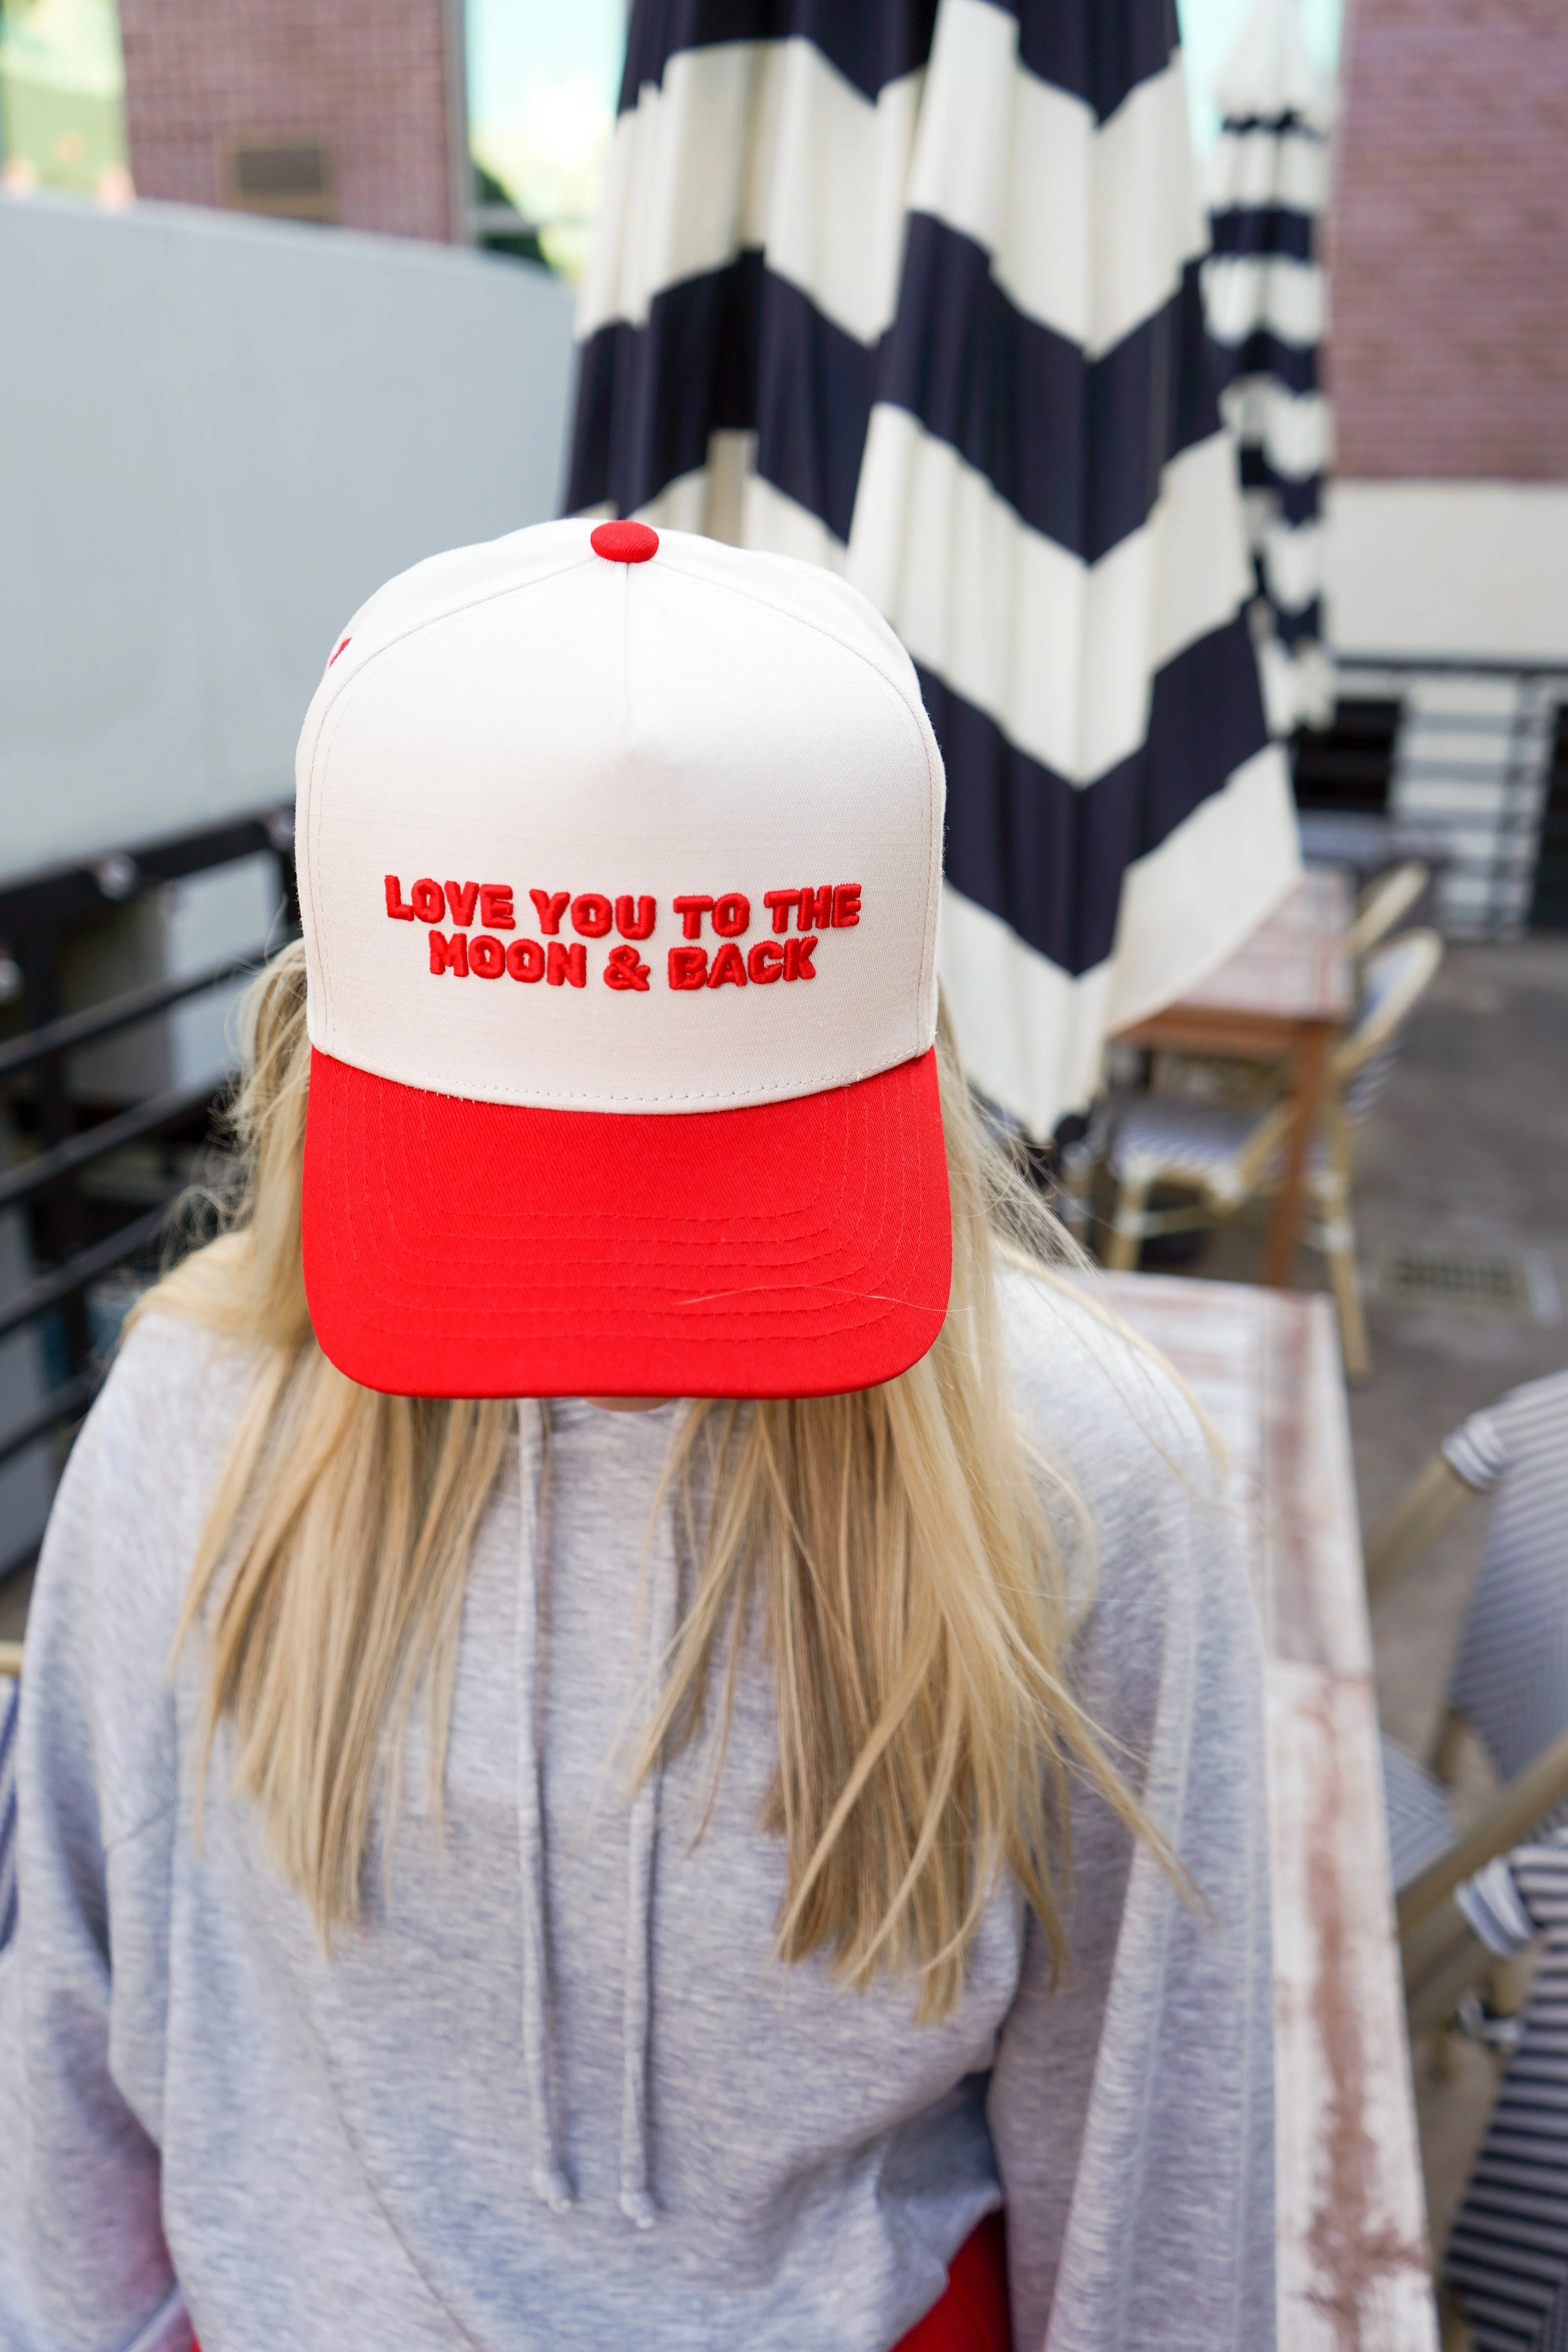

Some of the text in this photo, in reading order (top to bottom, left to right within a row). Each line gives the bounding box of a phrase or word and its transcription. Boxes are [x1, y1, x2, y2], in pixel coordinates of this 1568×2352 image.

[384, 875, 862, 941] LOVE YOU TO THE
[428, 929, 818, 991] MOON & BACK
